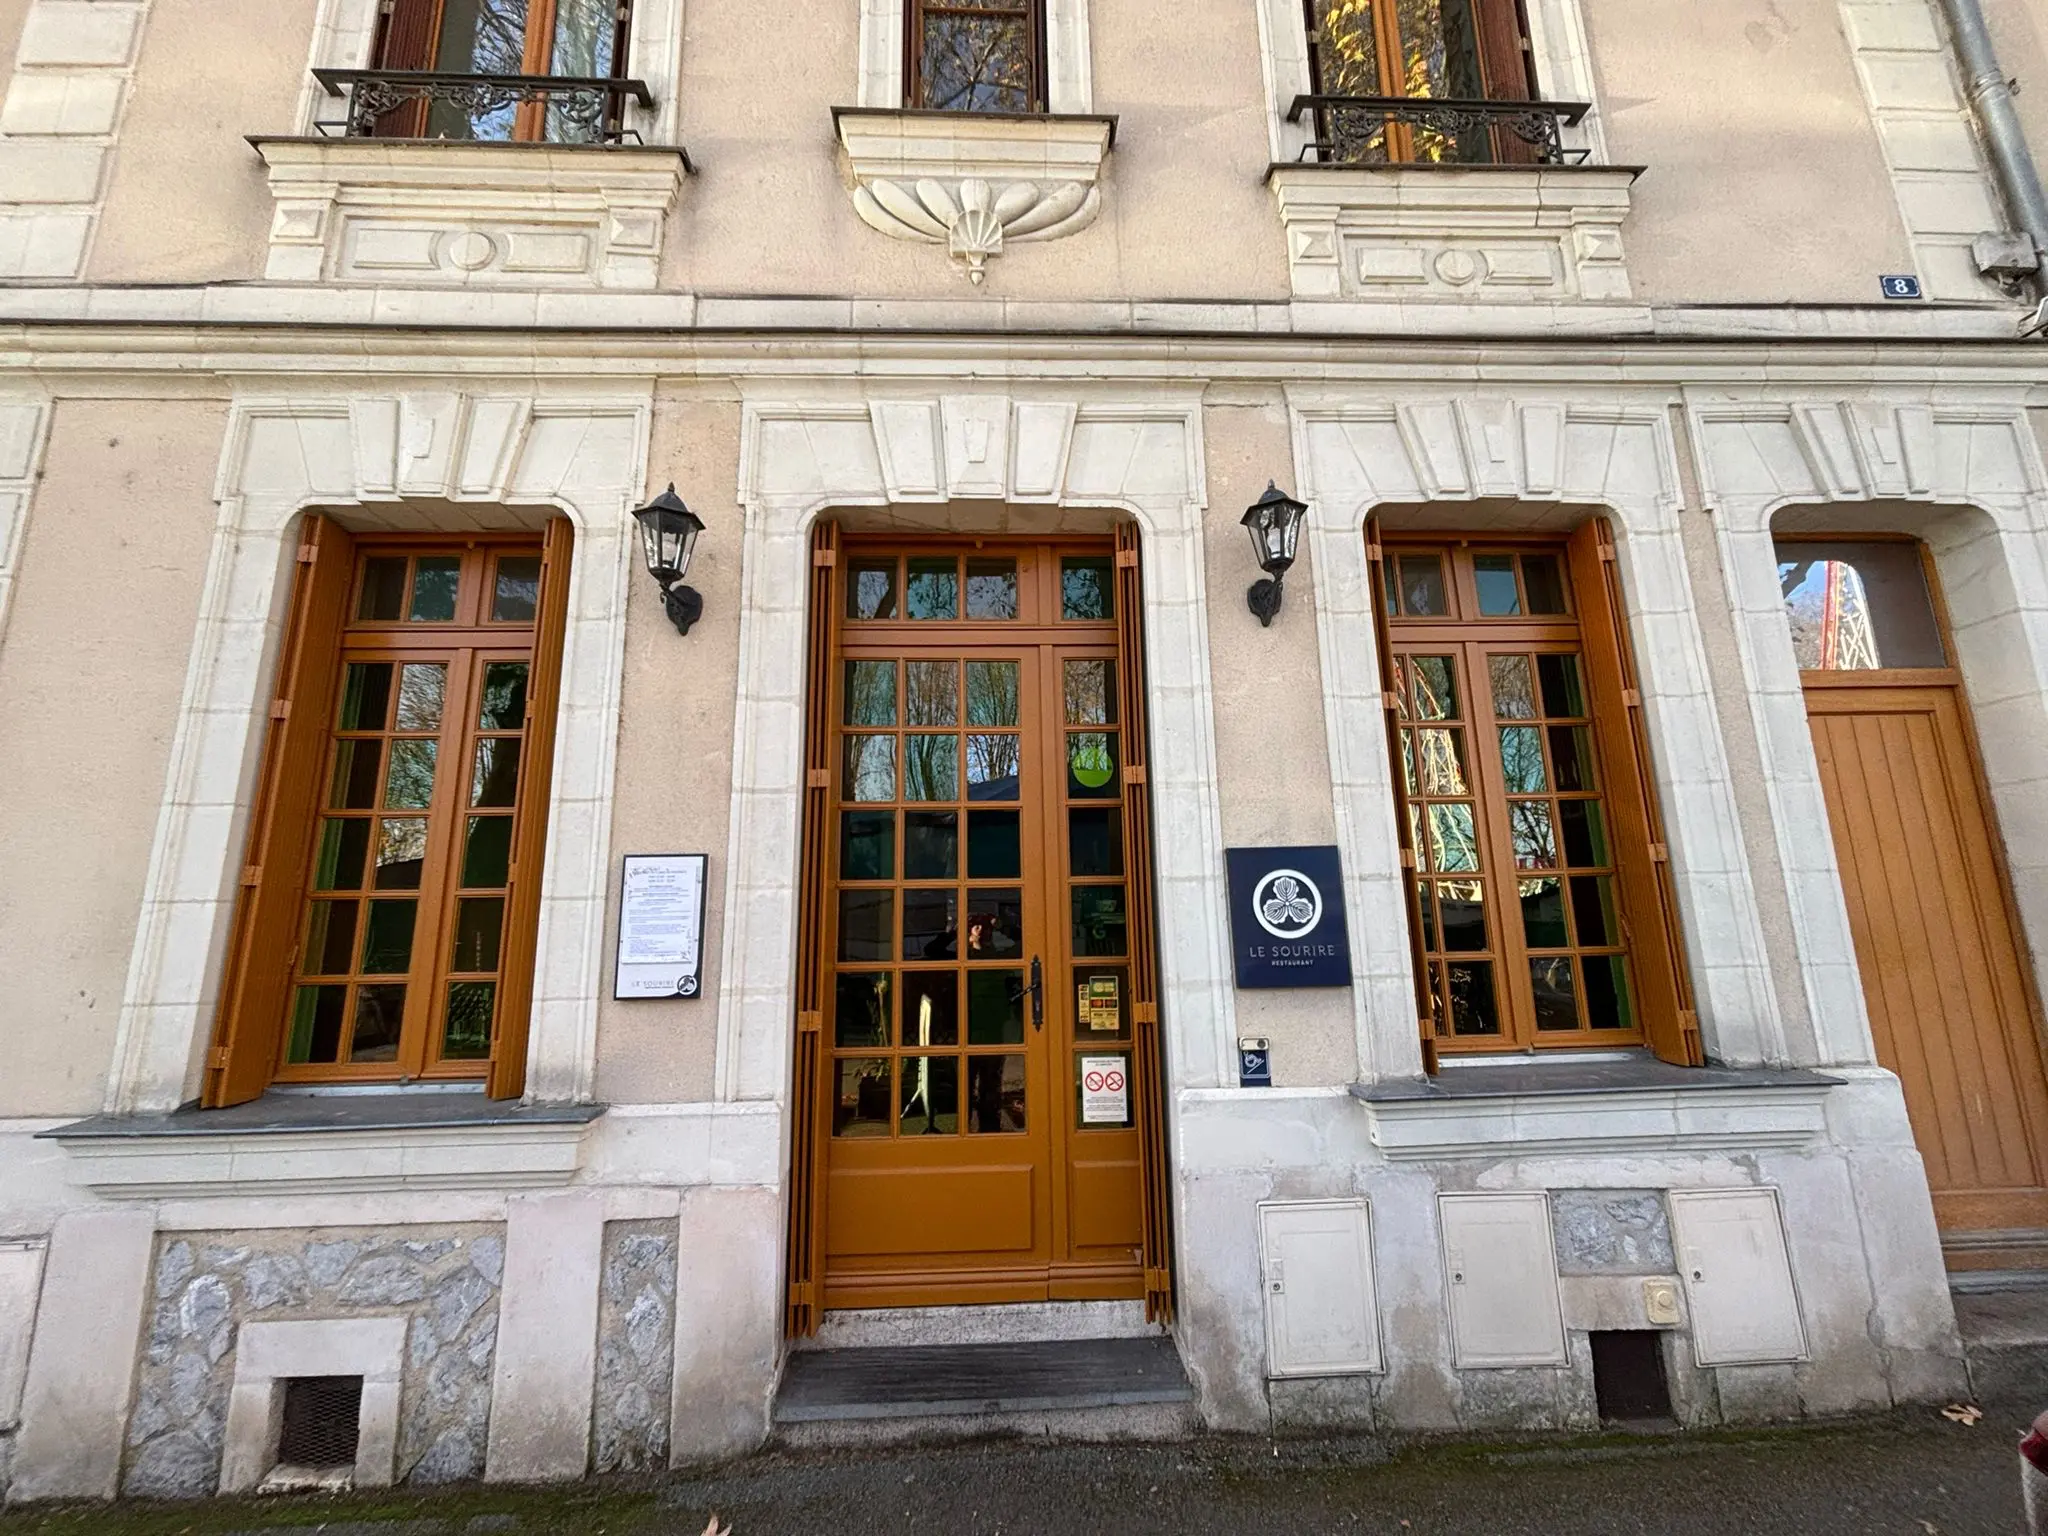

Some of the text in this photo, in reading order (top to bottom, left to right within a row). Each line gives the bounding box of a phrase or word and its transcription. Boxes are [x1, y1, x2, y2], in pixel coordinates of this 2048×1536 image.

[1894, 279, 1908, 293] 8
[1249, 945, 1335, 957] LE SOURIRE
